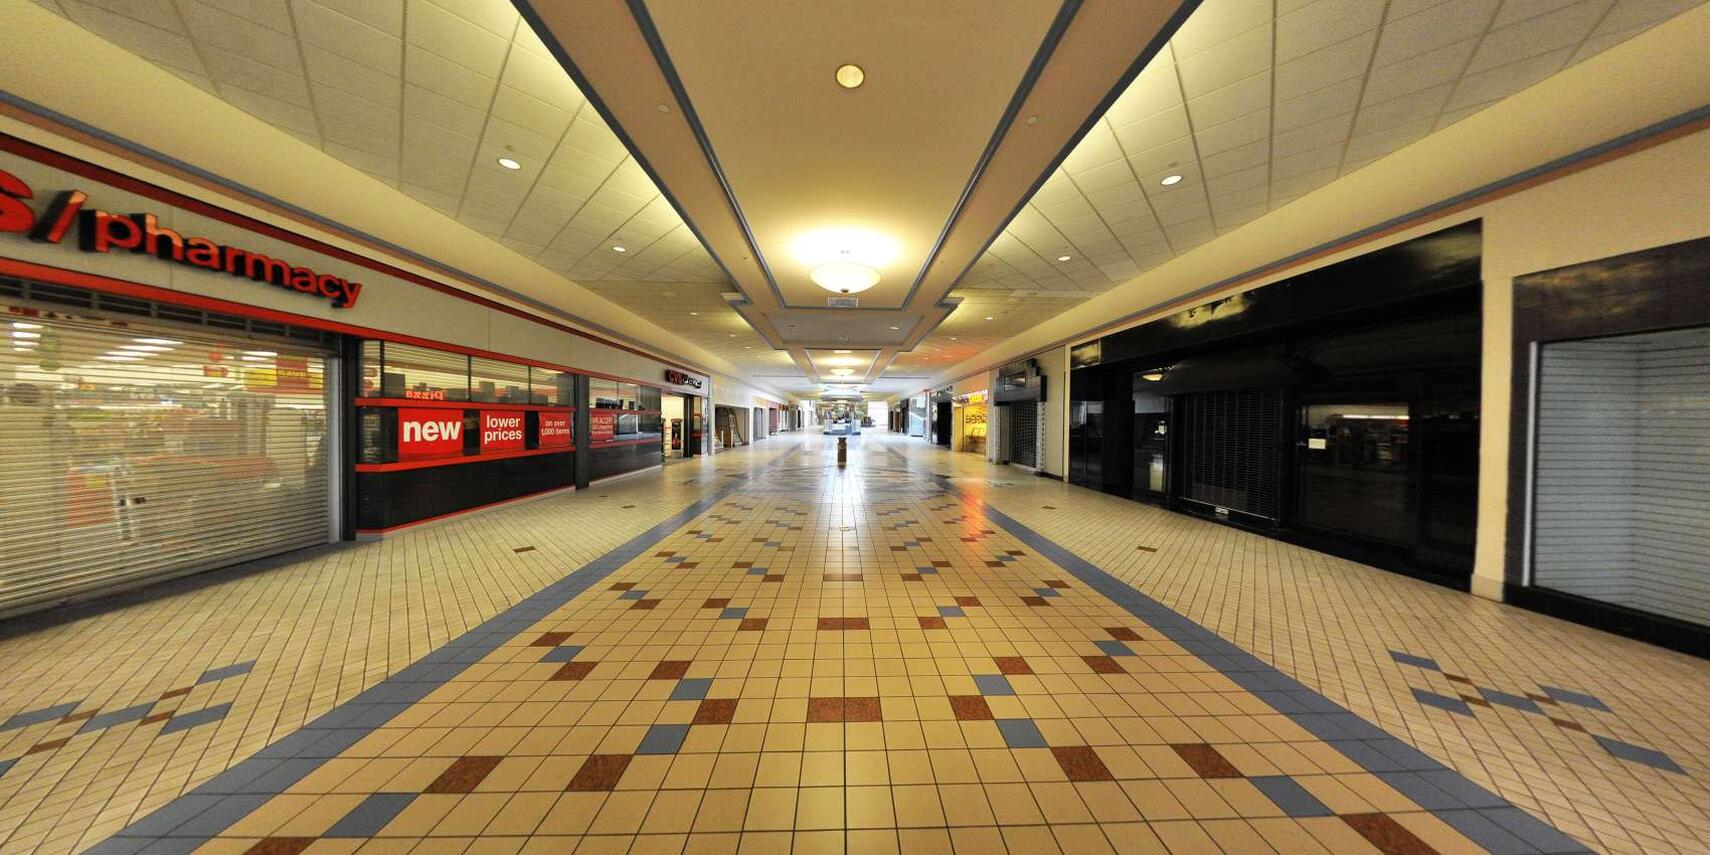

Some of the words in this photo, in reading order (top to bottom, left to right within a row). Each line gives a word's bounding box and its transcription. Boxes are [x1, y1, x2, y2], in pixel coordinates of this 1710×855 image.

[486, 414, 521, 428] lower
[545, 420, 553, 428] on
[553, 420, 566, 428] over
[403, 420, 462, 442] new
[484, 428, 523, 445] prices
